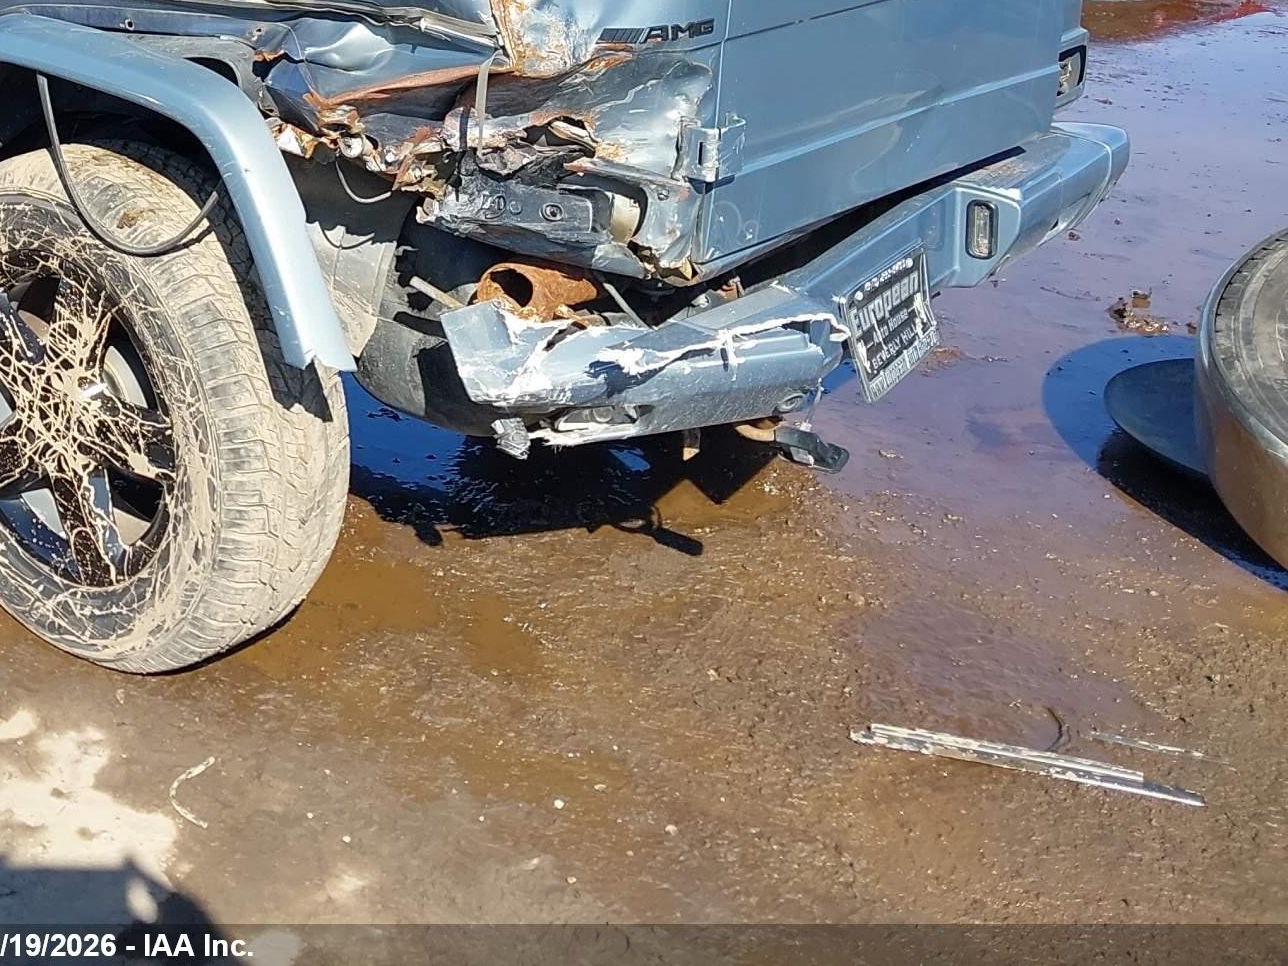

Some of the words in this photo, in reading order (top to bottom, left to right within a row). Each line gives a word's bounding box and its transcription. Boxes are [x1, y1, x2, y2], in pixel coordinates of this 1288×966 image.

[640, 18, 714, 44] AMG
[848, 270, 919, 338] European
[872, 336, 901, 370] BEVERLY
[900, 321, 924, 345] HILL
[873, 324, 890, 346] Ato
[888, 308, 909, 331] House
